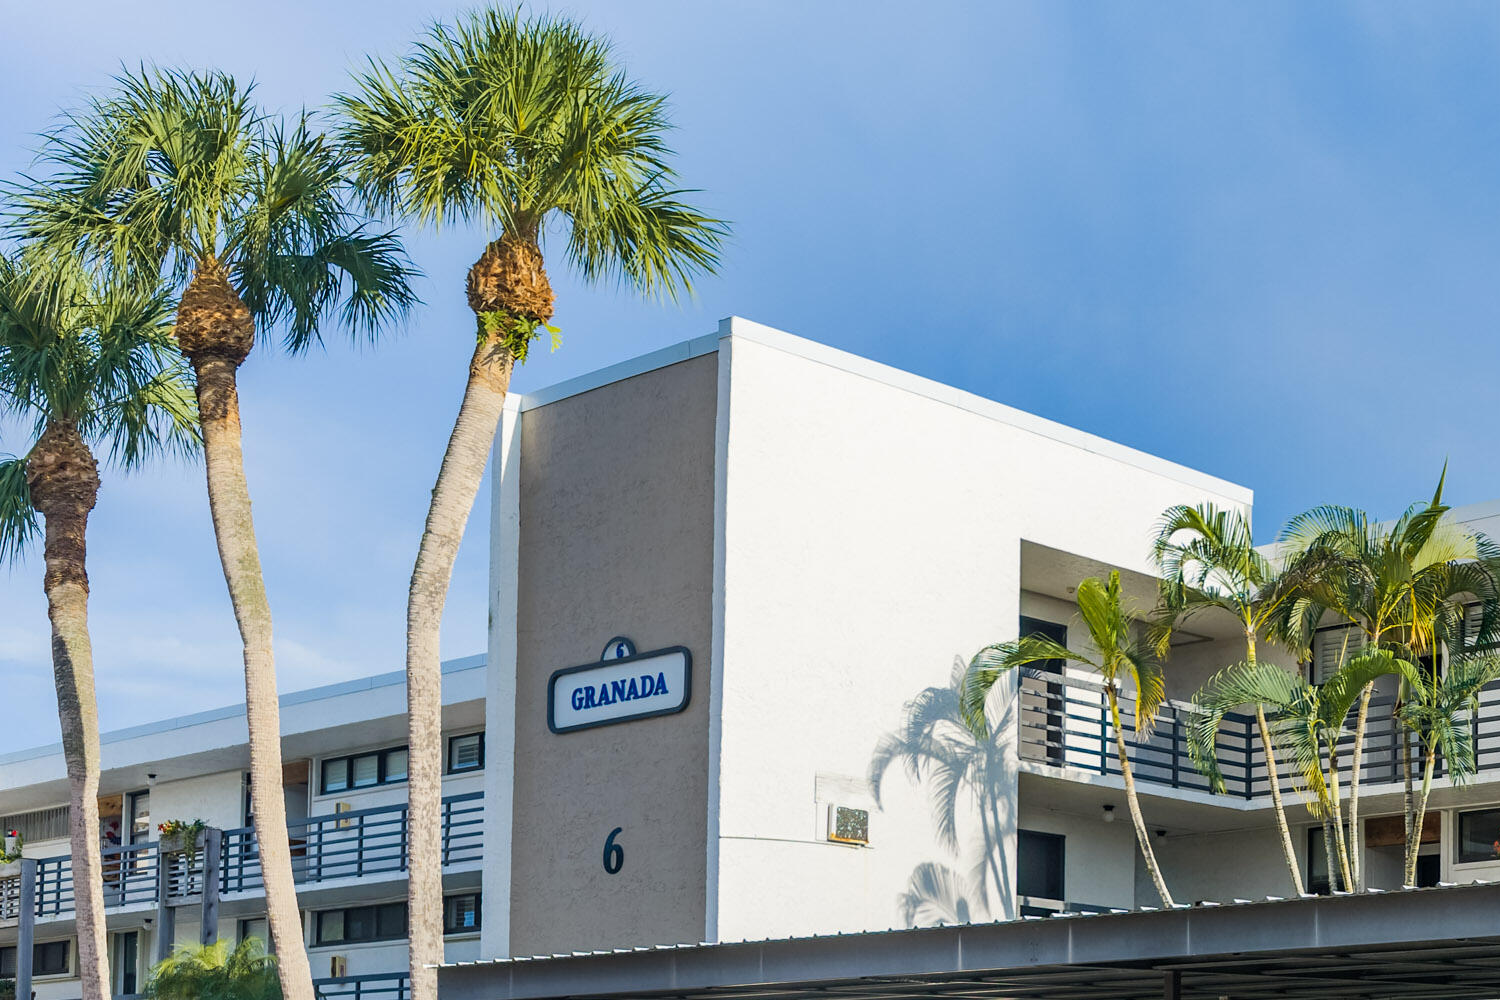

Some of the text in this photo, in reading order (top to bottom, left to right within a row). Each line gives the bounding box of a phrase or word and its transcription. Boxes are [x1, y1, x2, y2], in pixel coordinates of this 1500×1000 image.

[616, 642, 625, 659] 6
[571, 672, 669, 711] GRANADA
[603, 826, 624, 875] 6
